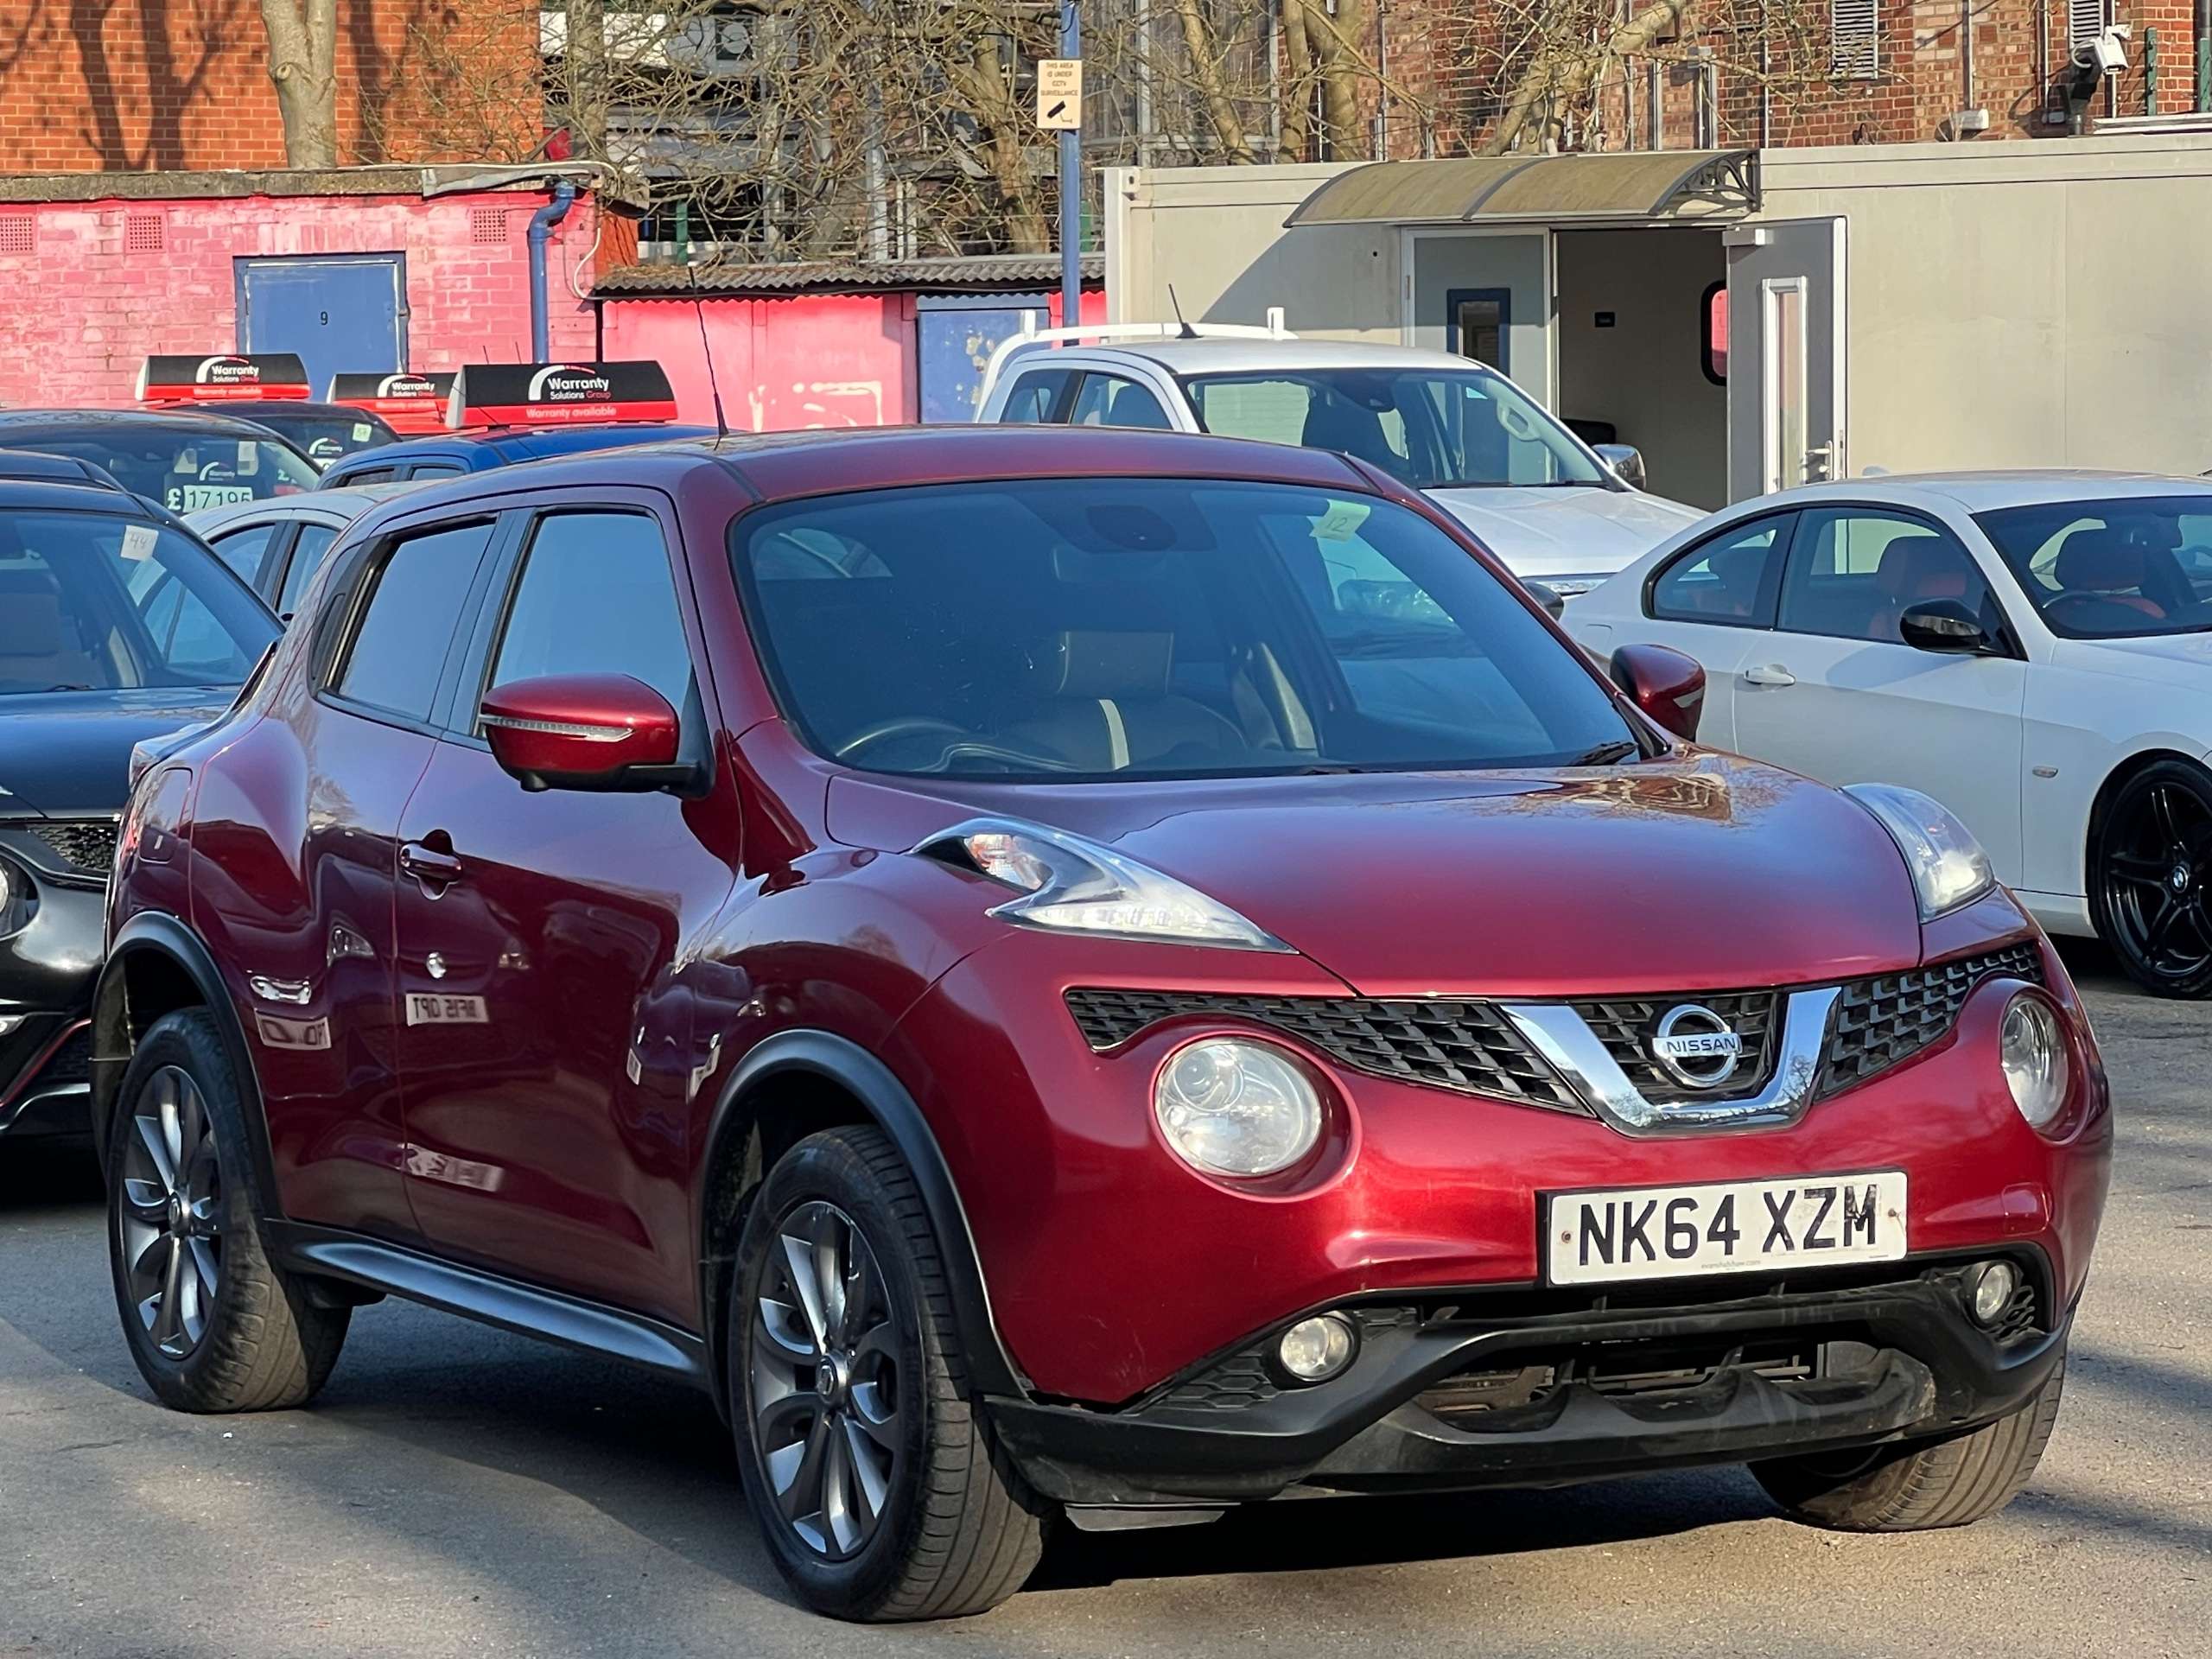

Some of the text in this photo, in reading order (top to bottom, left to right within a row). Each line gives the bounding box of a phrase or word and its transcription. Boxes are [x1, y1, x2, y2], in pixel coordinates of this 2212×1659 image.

[320, 311, 328, 326] 9
[212, 365, 259, 377] Warranty
[391, 381, 435, 391] Warranty
[547, 378, 609, 391] Warranty
[550, 391, 612, 400] Solutions Group
[525, 406, 617, 419] Warranty available
[1665, 1037, 1736, 1052] NISSAN
[1579, 1184, 1878, 1267] NK64 XZM
